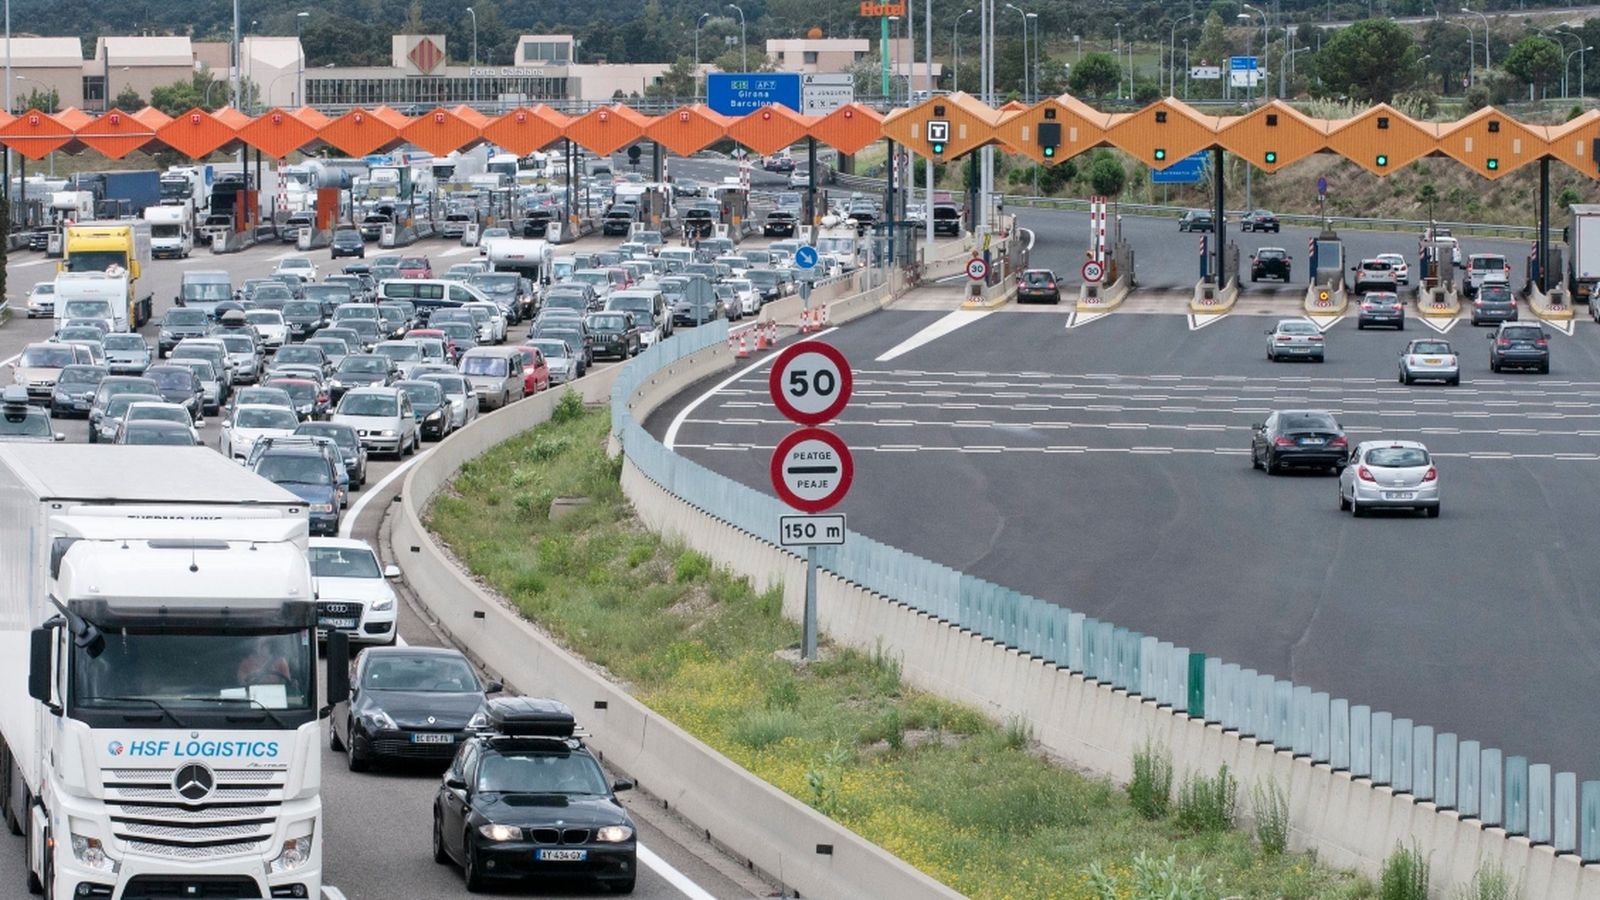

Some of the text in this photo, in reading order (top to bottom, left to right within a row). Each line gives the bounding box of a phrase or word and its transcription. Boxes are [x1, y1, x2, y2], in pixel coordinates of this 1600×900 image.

[861, 0, 905, 16] Hotel
[501, 67, 544, 76] Catalana
[738, 90, 769, 98] Girona
[932, 126, 945, 137] T
[971, 265, 983, 273] 30
[1087, 267, 1099, 276] 30
[790, 369, 835, 397] 50
[793, 452, 831, 460] PEATGE
[797, 480, 828, 488] PEAJE
[785, 523, 840, 538] 150 m
[130, 741, 279, 757] HSF LOGISTICS
